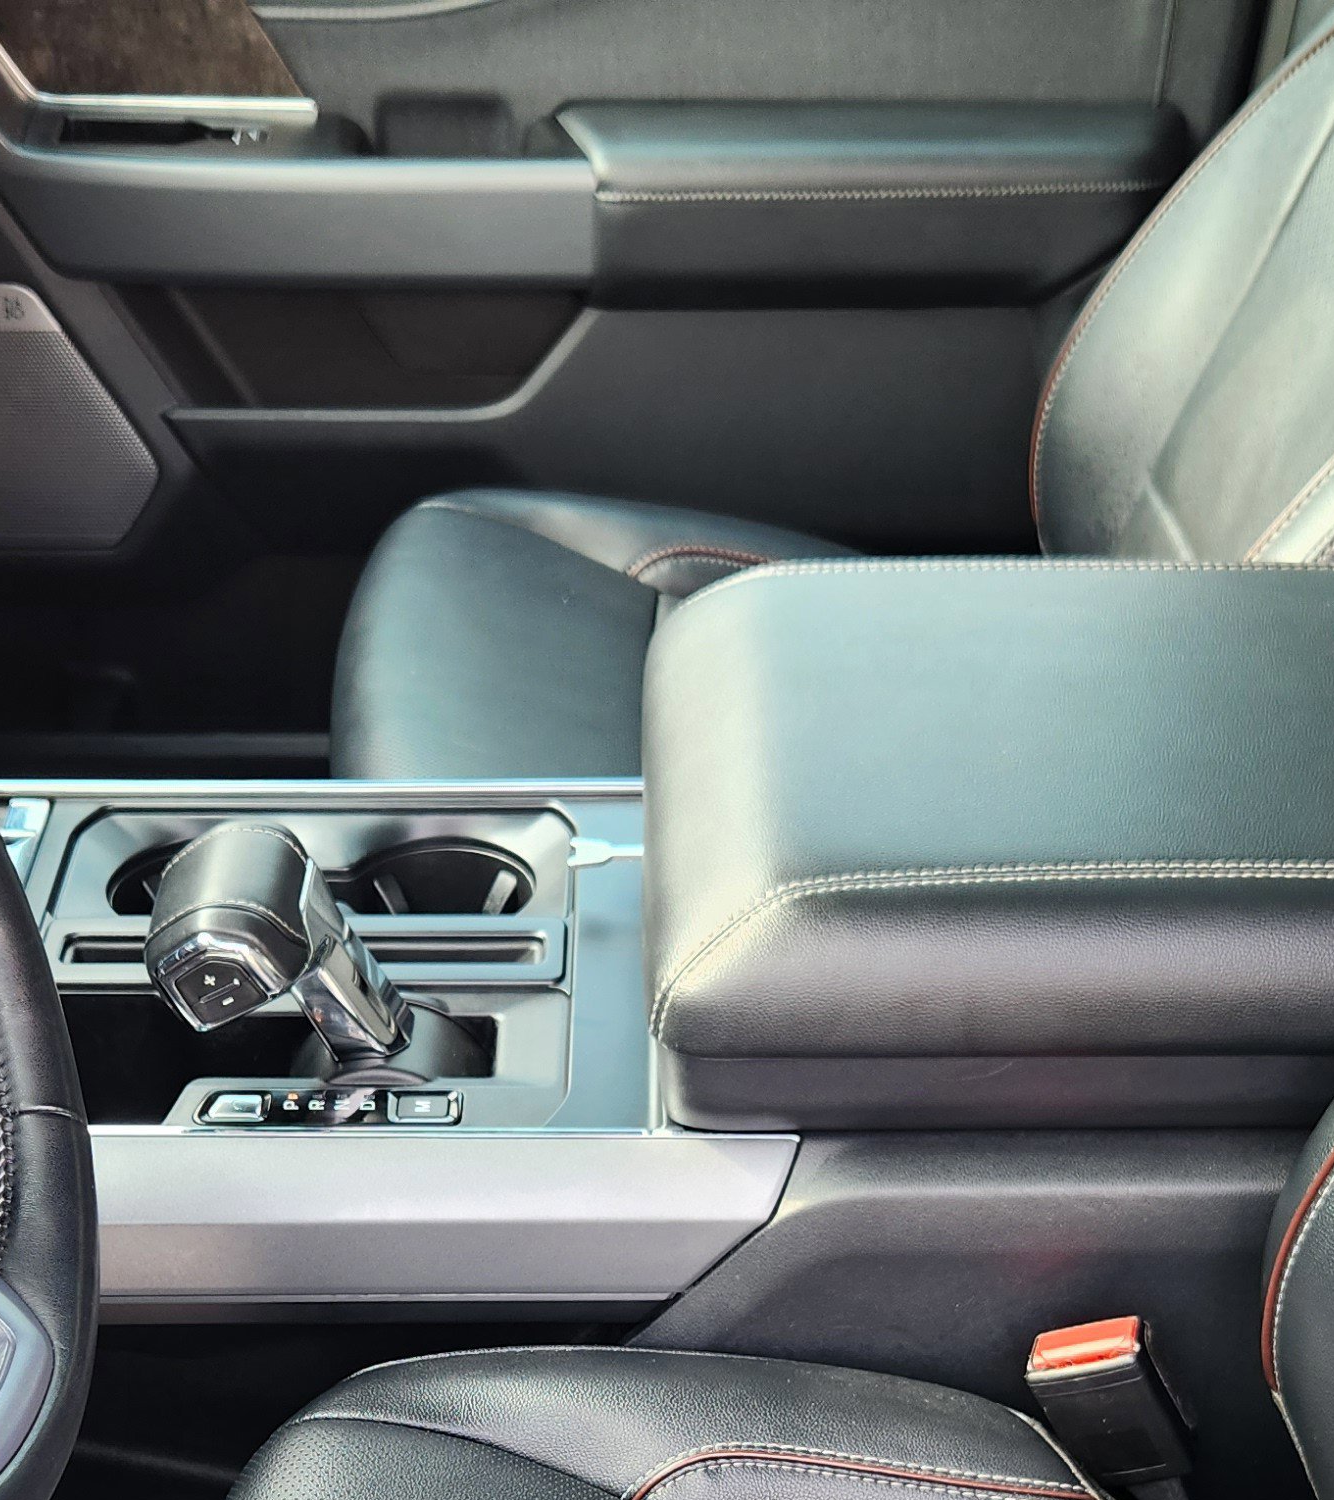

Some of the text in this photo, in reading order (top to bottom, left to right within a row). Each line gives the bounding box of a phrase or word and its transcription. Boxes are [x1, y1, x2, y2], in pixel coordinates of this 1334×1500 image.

[282, 1100, 299, 1111] P
[308, 1100, 325, 1111] R
[359, 1100, 375, 1111] D
[414, 1100, 430, 1113] M
